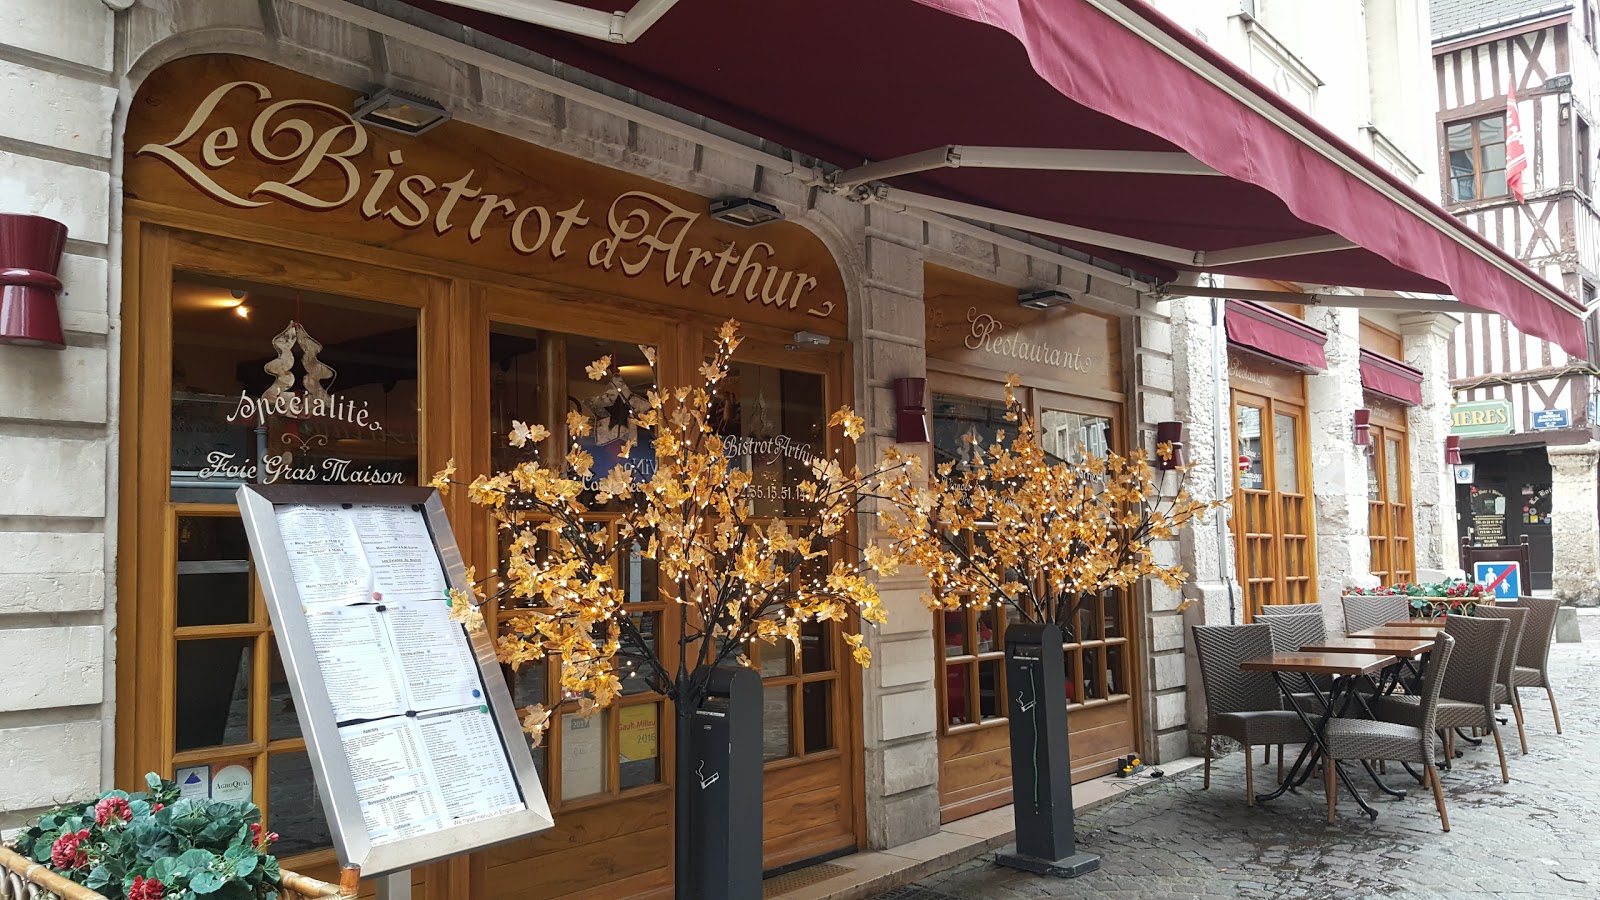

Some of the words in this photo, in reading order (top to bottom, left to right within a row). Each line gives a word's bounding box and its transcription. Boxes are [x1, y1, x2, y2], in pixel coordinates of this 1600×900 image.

[137, 80, 273, 208] Le
[247, 98, 593, 256] Bistrot
[964, 306, 1089, 373] Restaurant
[227, 389, 380, 430] Spécialité
[722, 433, 774, 458] Bistrot
[199, 451, 258, 480] Foie
[262, 454, 319, 486] Gras
[322, 457, 406, 486] Maison
[637, 733, 656, 744] 2016
